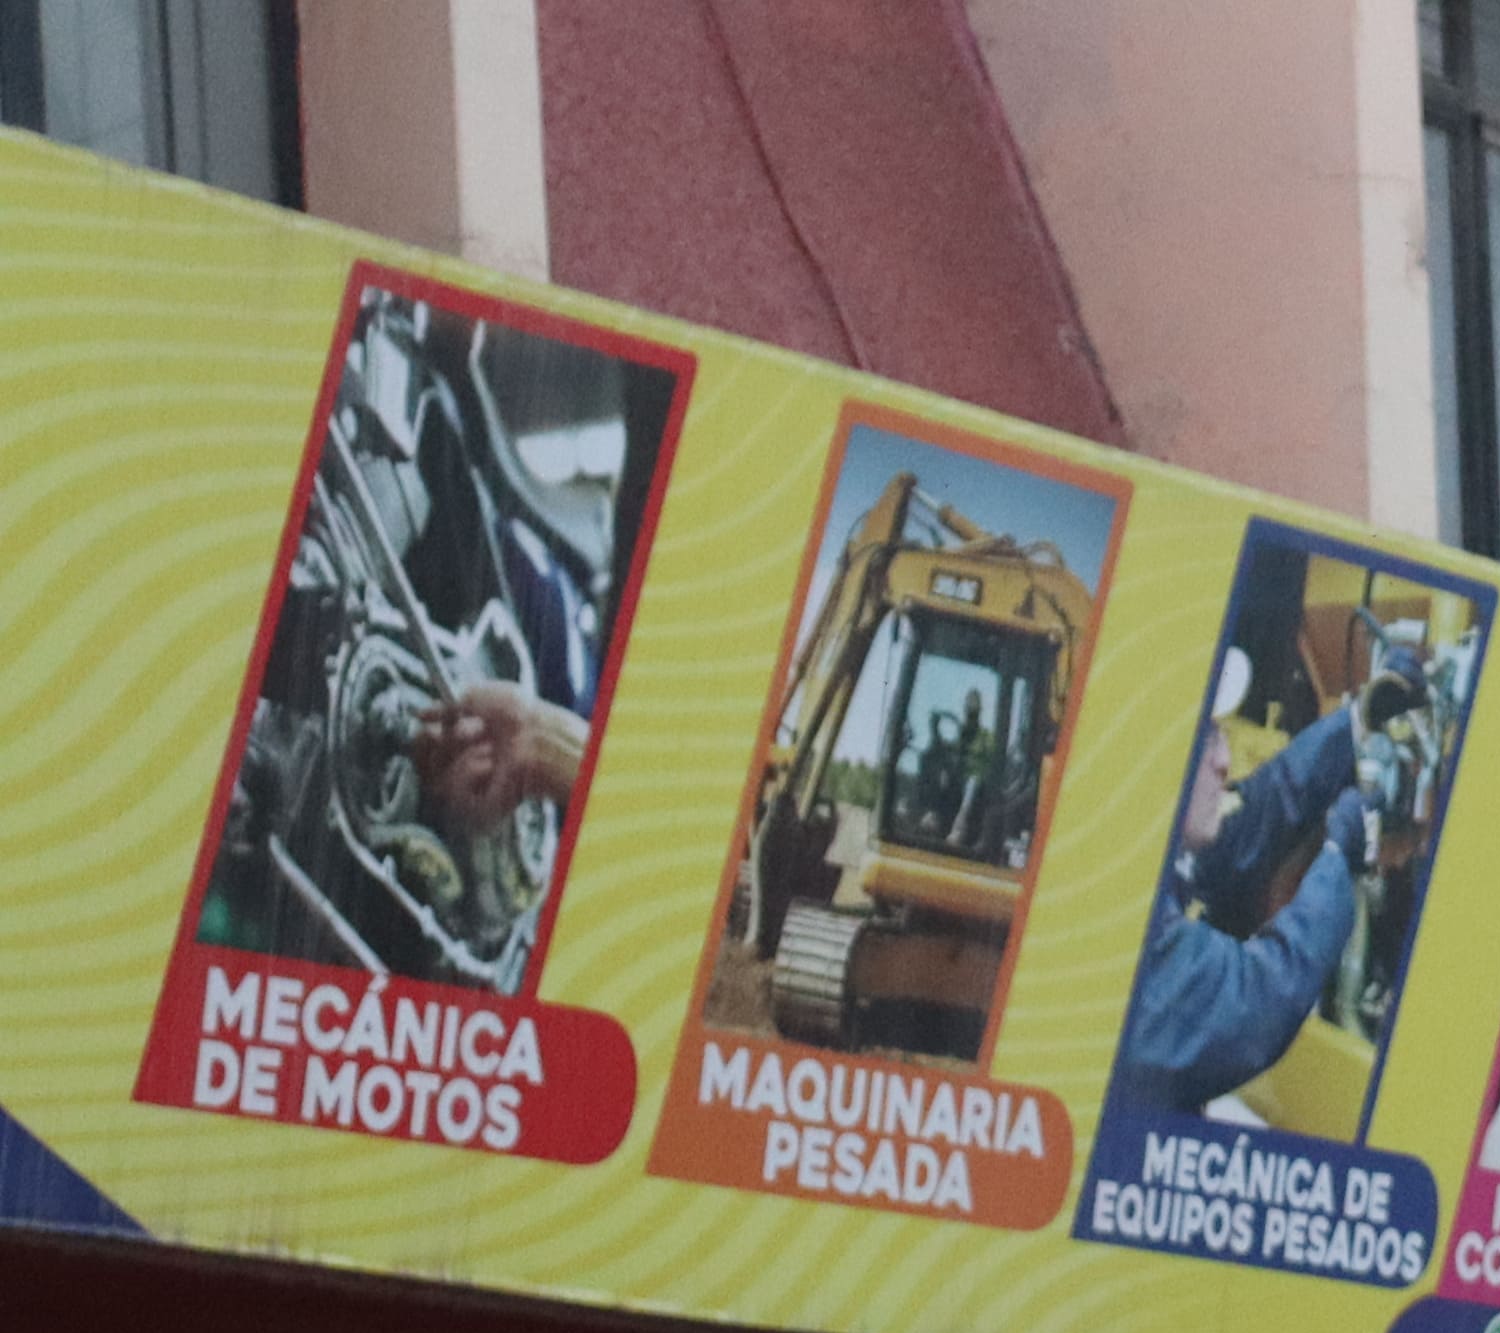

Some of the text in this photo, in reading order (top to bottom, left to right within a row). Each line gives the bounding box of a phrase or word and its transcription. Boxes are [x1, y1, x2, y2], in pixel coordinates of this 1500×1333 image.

[202, 967, 544, 1085] MECÁNICA
[193, 1039, 521, 1150] DE MOTOS
[700, 1042, 1046, 1160] MAQUINARIA
[762, 1122, 973, 1212] PESADA
[1143, 1131, 1392, 1224] MECÁNICA DE
[1092, 1179, 1425, 1284] EQUIPOS PESADOS
